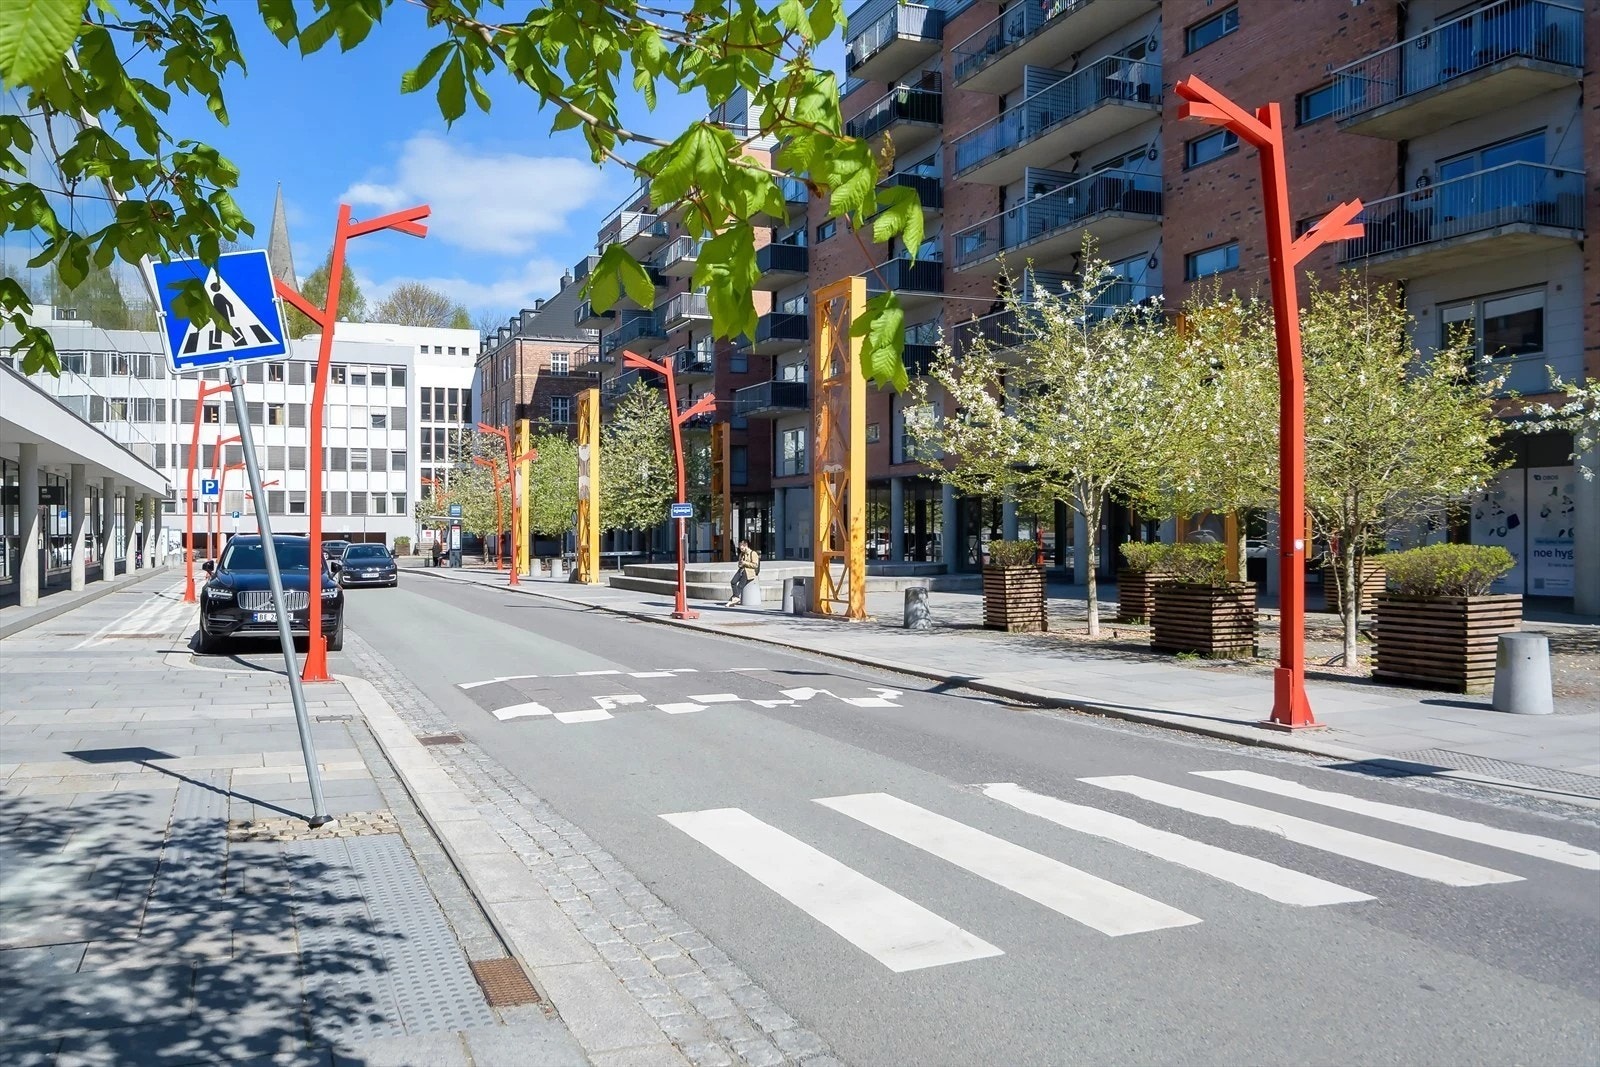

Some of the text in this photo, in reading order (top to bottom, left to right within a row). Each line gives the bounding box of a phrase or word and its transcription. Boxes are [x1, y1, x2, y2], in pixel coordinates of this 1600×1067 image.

[205, 481, 214, 494] P
[1534, 548, 1574, 560] noe hyg
